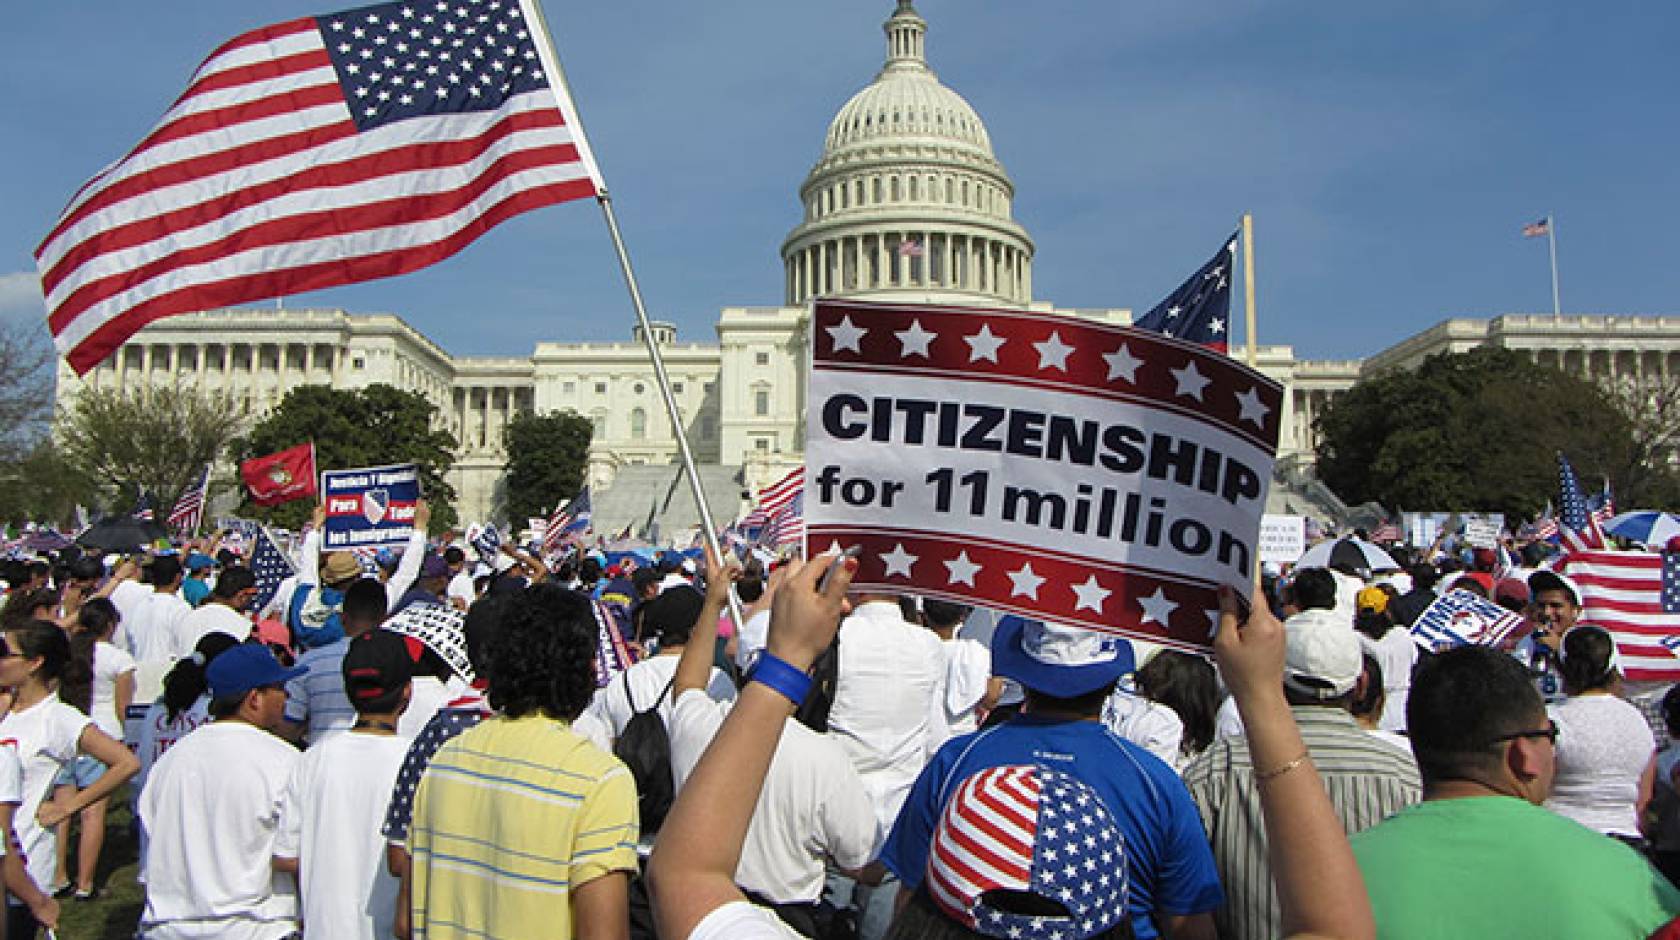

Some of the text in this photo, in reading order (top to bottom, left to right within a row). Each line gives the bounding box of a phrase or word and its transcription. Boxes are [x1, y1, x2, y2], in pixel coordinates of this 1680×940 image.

[821, 393, 1261, 505] CITIZENSHIP
[815, 465, 904, 508] for
[924, 466, 990, 517] 11
[1001, 483, 1249, 579] million
